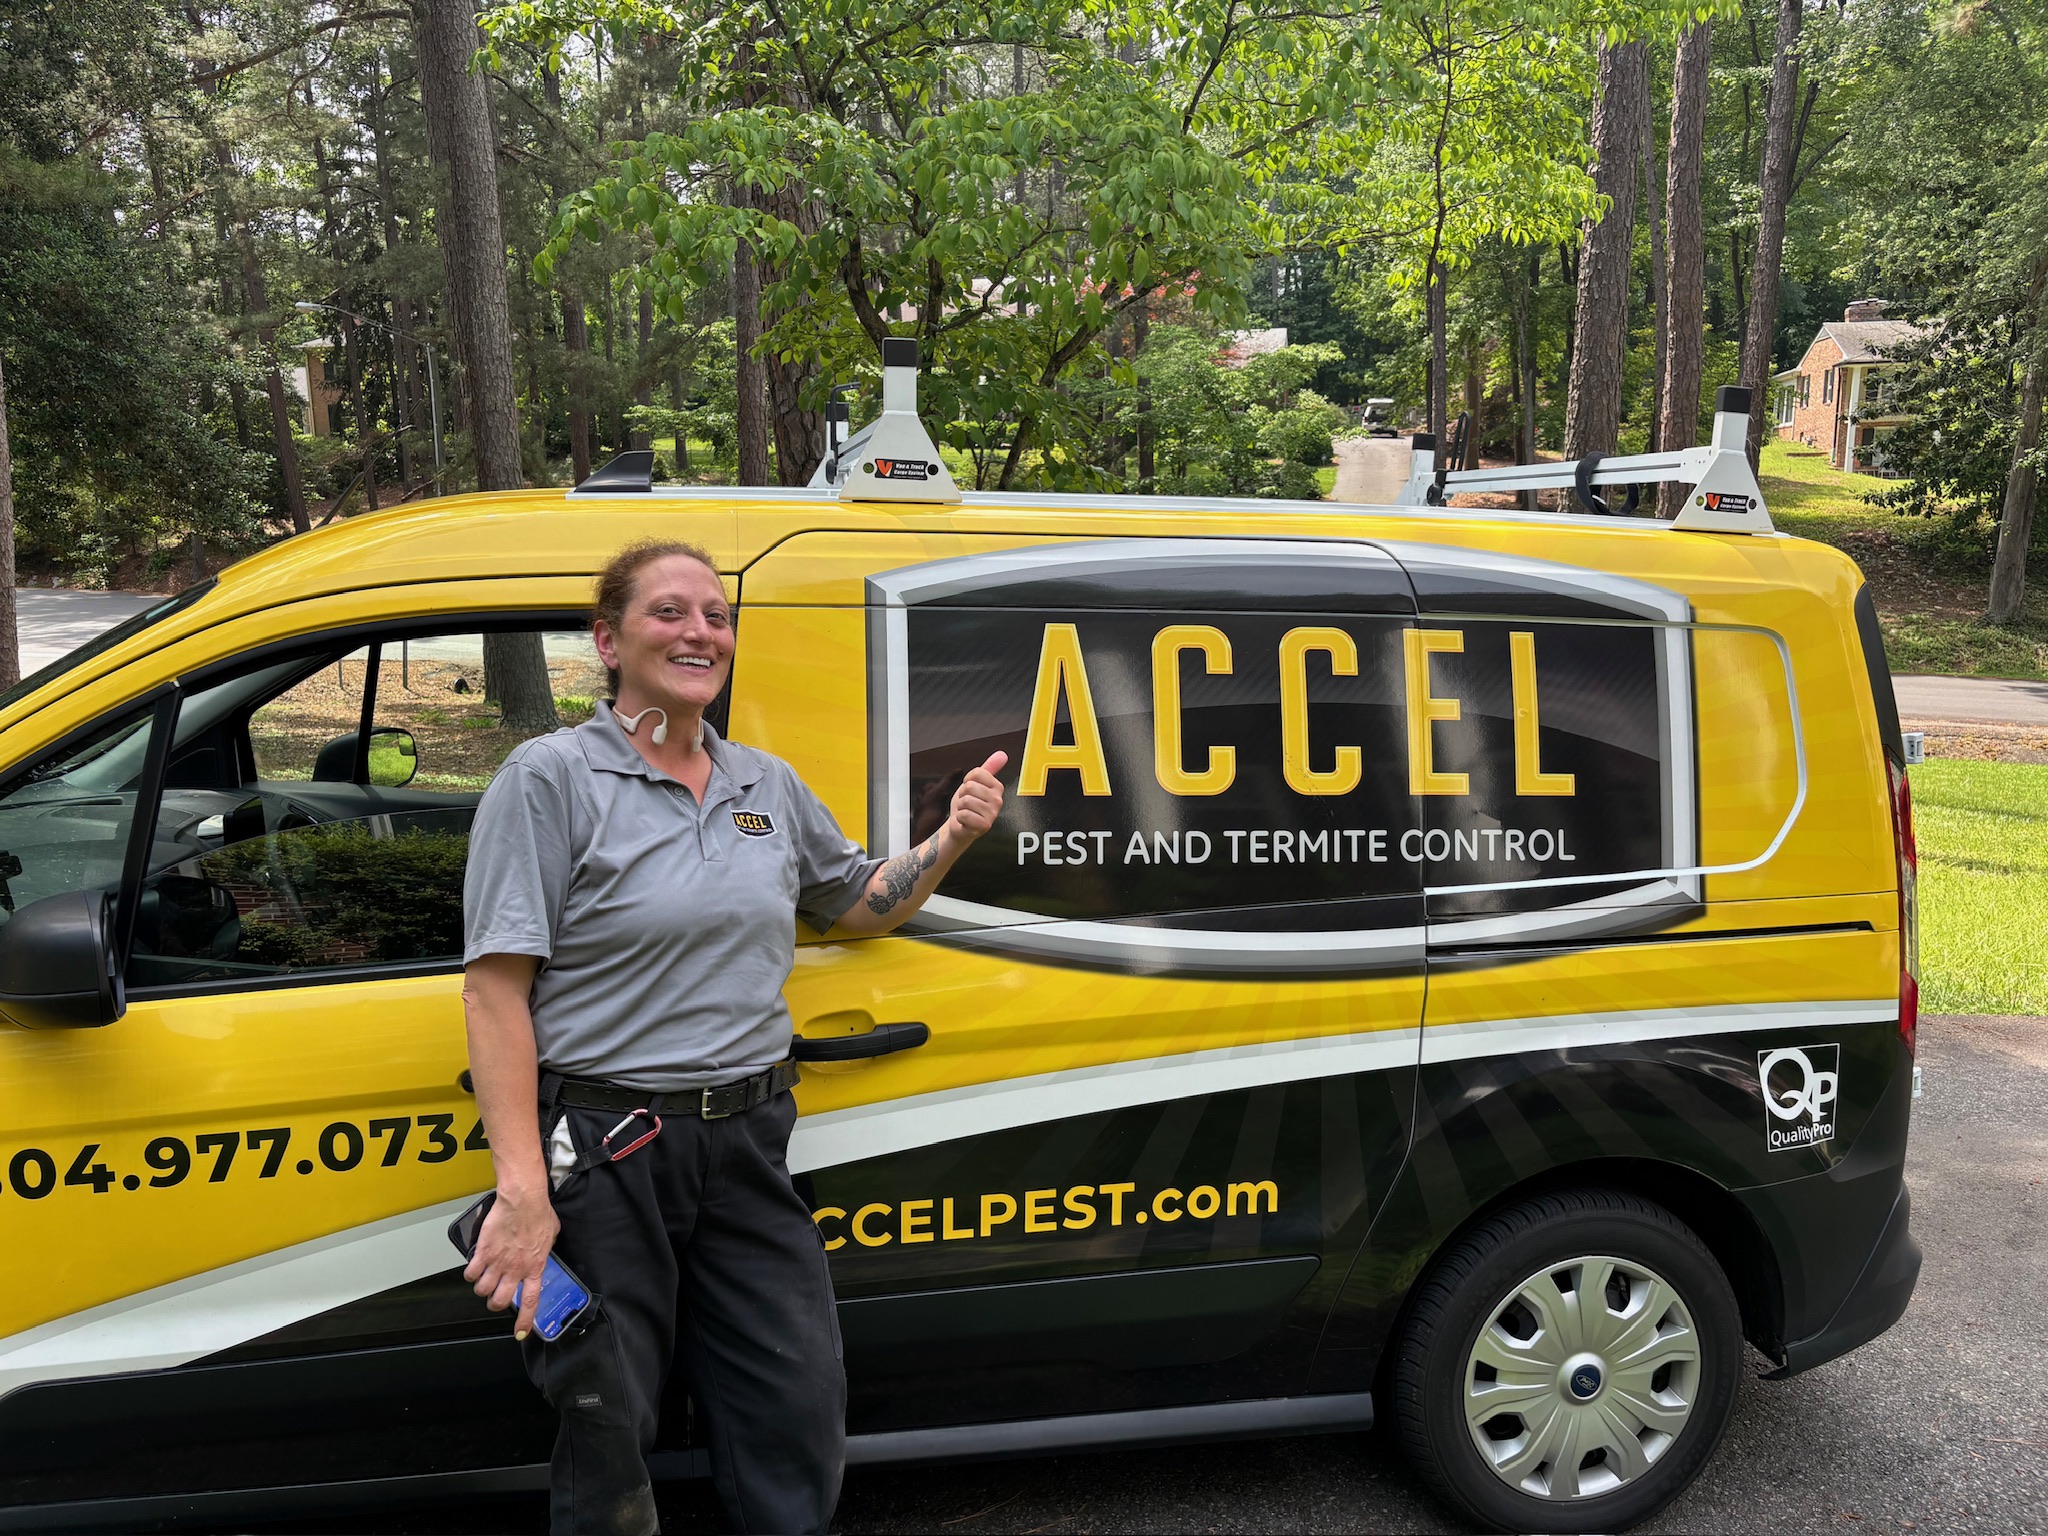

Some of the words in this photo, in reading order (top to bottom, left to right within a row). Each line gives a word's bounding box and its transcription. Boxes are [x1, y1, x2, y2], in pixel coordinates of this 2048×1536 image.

[1018, 623, 1577, 797] ACCEL
[734, 813, 767, 829] ACCEL
[1017, 831, 1113, 866] PEST
[1123, 830, 1212, 865] AND
[1223, 829, 1388, 864] TERMITE
[1400, 828, 1576, 862] CONTROL
[1770, 1122, 1832, 1147] QualityPro
[0, 1113, 490, 1200] 04.977.073
